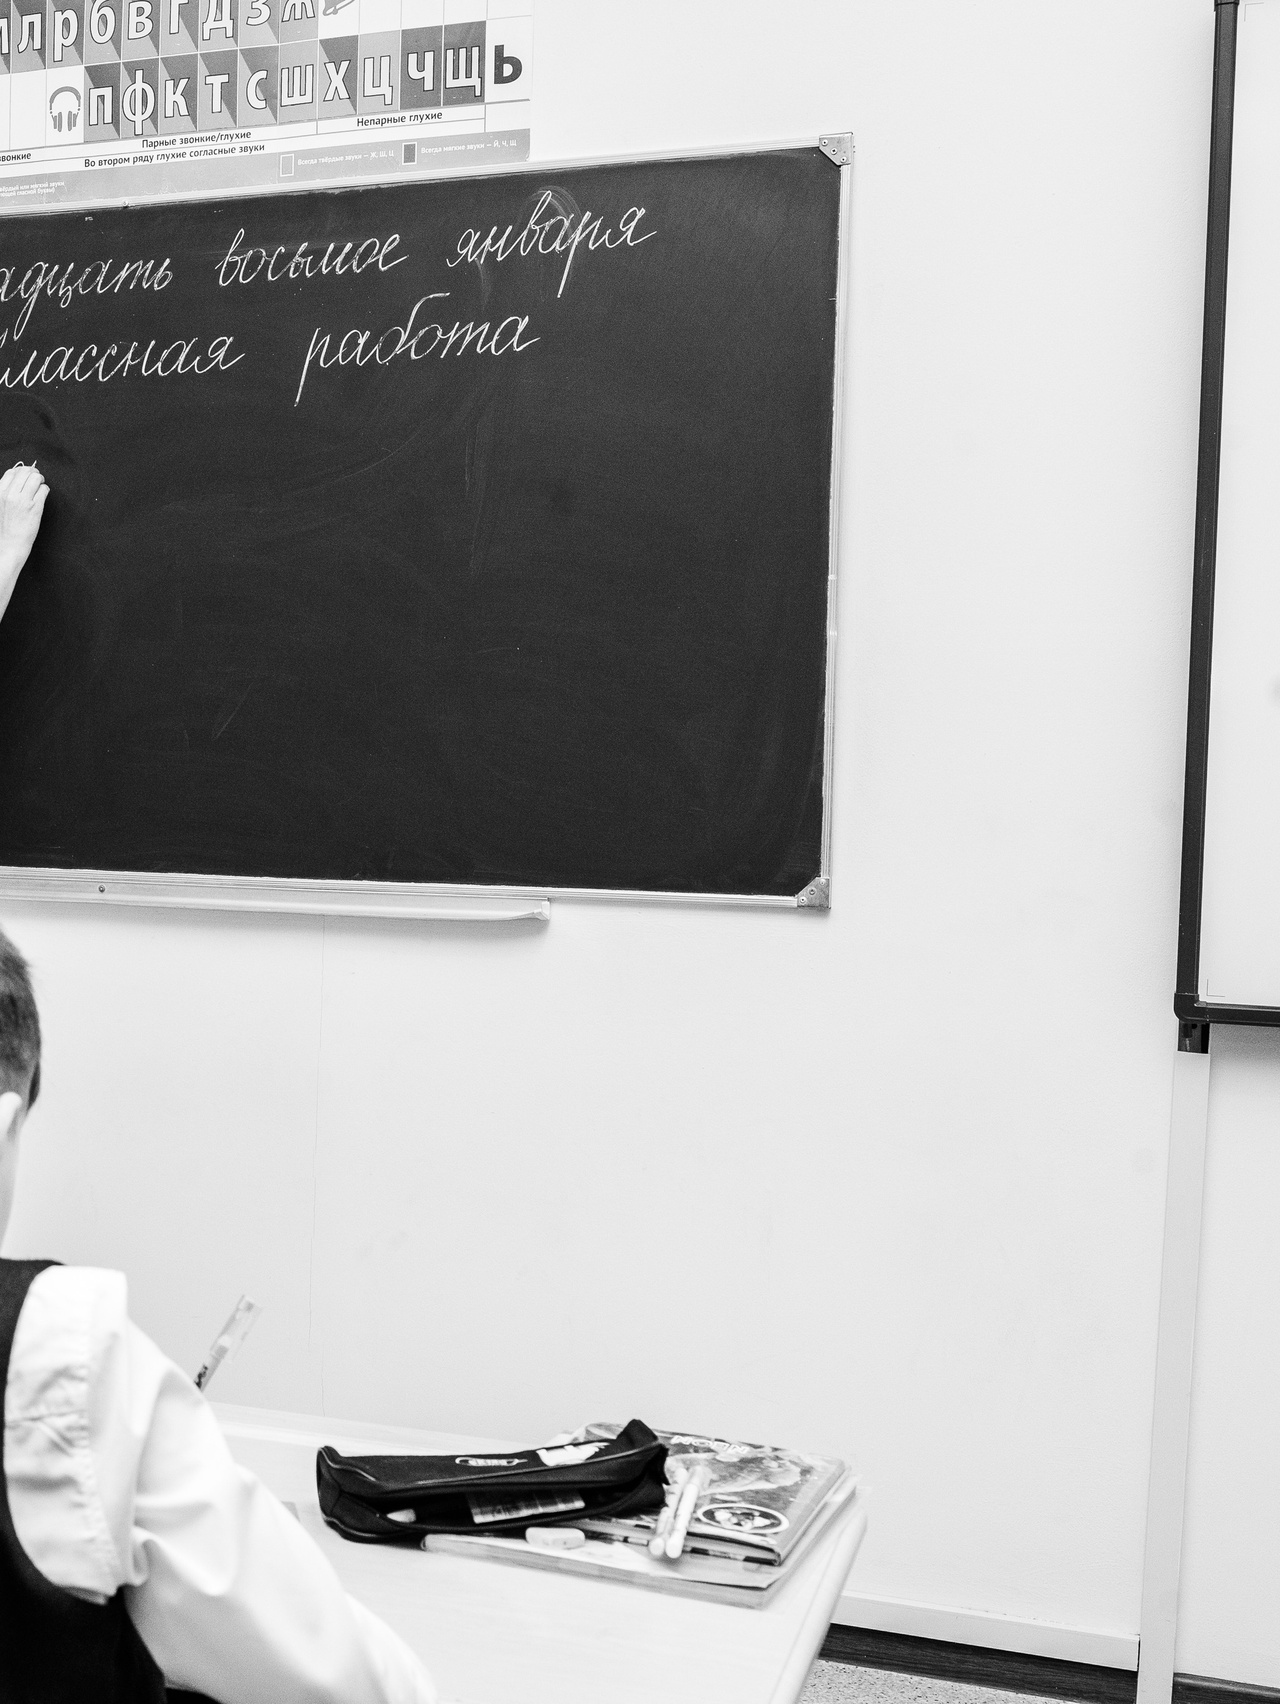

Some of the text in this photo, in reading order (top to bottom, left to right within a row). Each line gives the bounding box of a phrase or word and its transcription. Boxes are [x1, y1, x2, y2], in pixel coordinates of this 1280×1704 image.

[356, 111, 443, 127] Непарные глухие
[142, 131, 252, 149] Парные звонкие/глухие
[84, 144, 265, 167] Во втором ряду глухие согласные звуки
[216, 228, 409, 288] восьмое
[446, 190, 658, 299] января
[294, 292, 540, 407] работа
